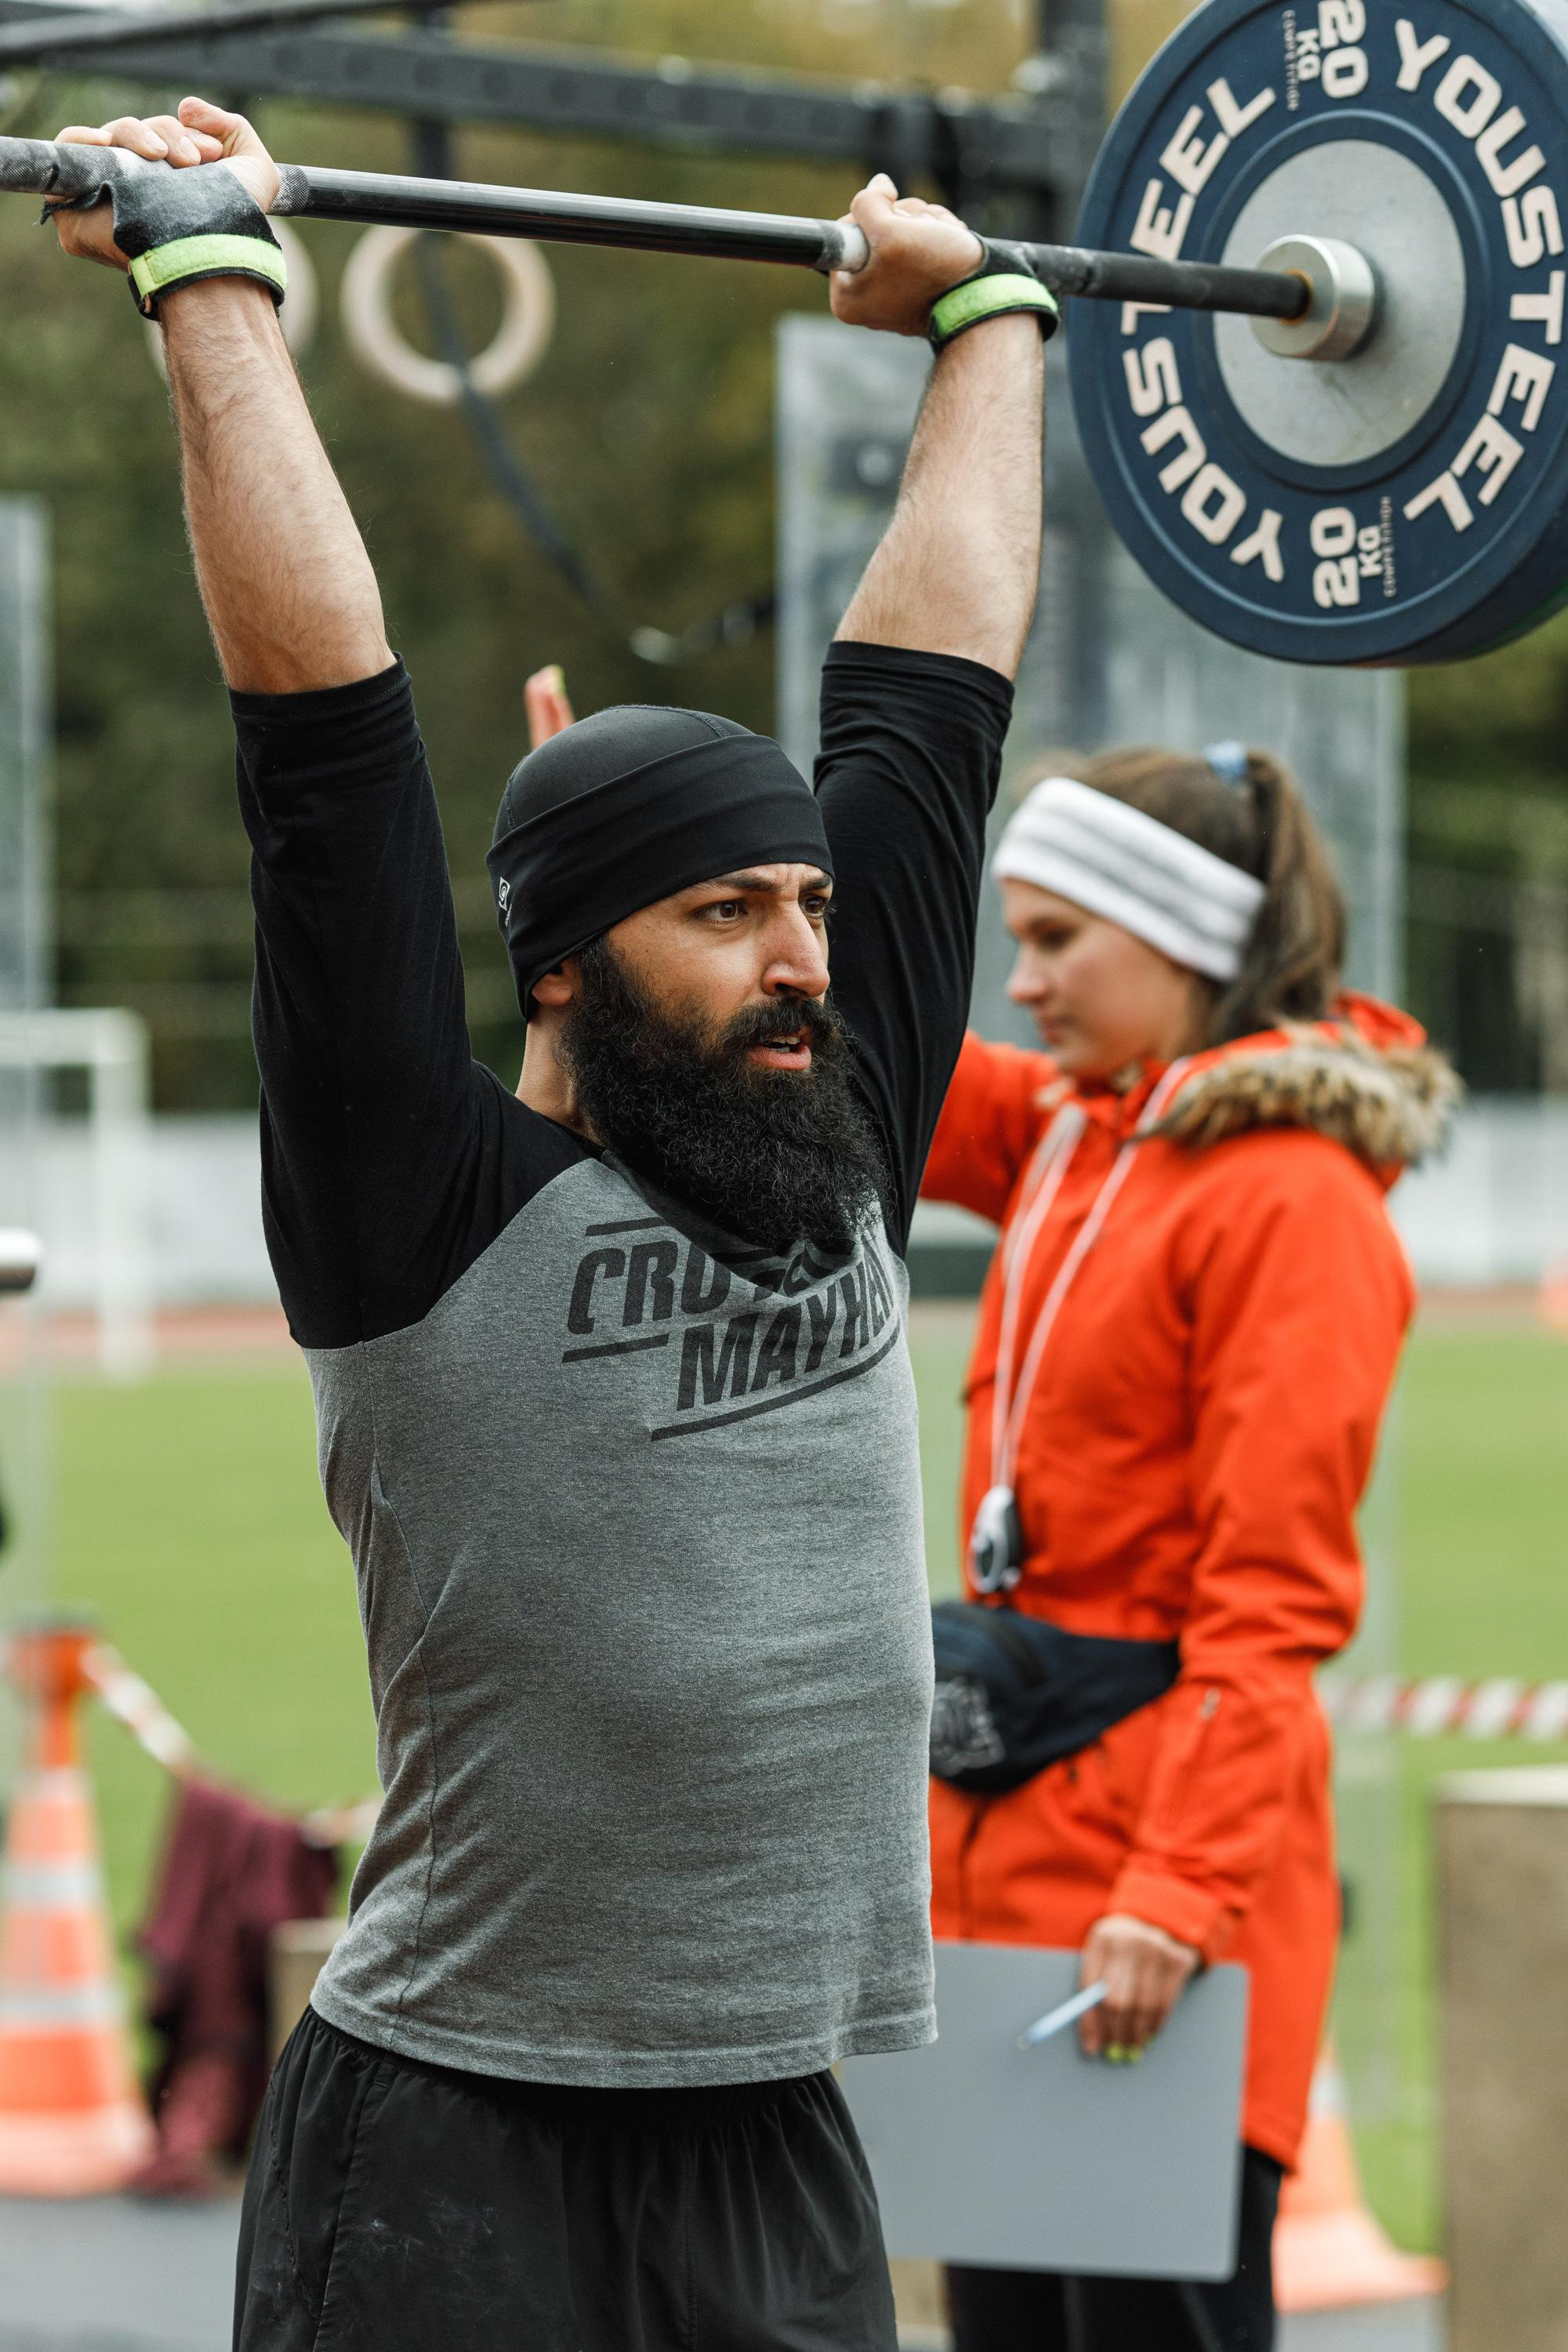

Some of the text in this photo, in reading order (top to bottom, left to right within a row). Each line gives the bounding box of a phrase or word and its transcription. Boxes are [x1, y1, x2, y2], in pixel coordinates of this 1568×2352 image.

[1318, 0, 1369, 99] 20
[1395, 18, 1565, 533] YOUSTEEL
[1310, 506, 1360, 608] 20
